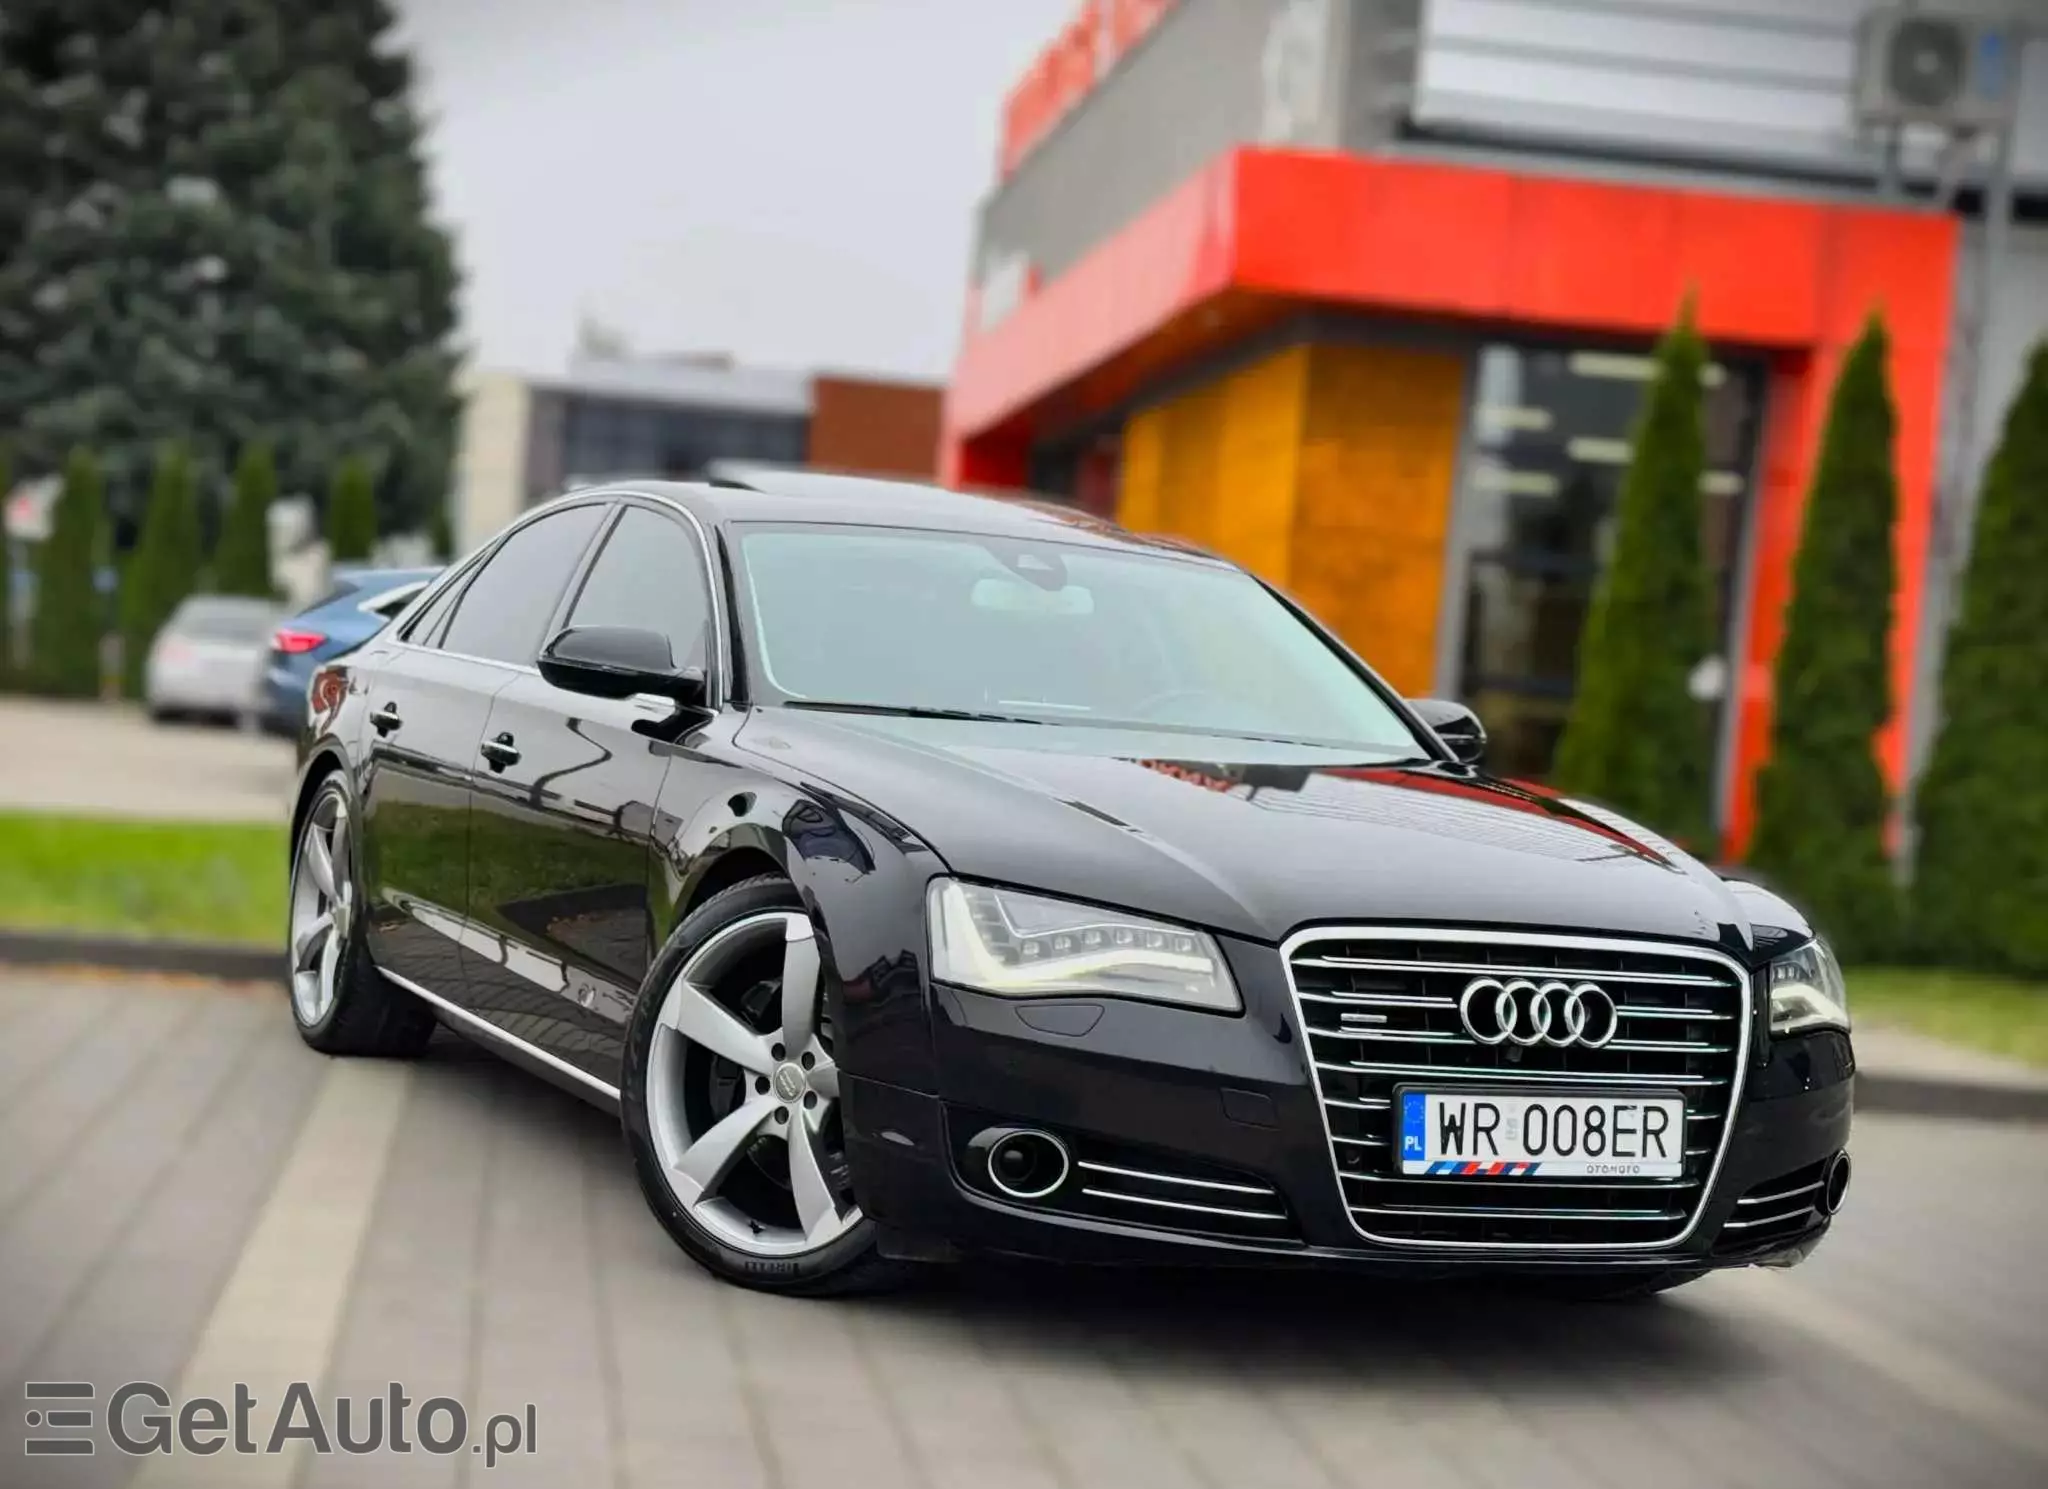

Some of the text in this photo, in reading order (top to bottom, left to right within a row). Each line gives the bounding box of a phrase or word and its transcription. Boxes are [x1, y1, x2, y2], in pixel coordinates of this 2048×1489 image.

[1439, 1102, 1669, 1158] WR 008ER
[1404, 1135, 1422, 1151] PL
[1586, 1164, 1641, 1174] OTOMOTO
